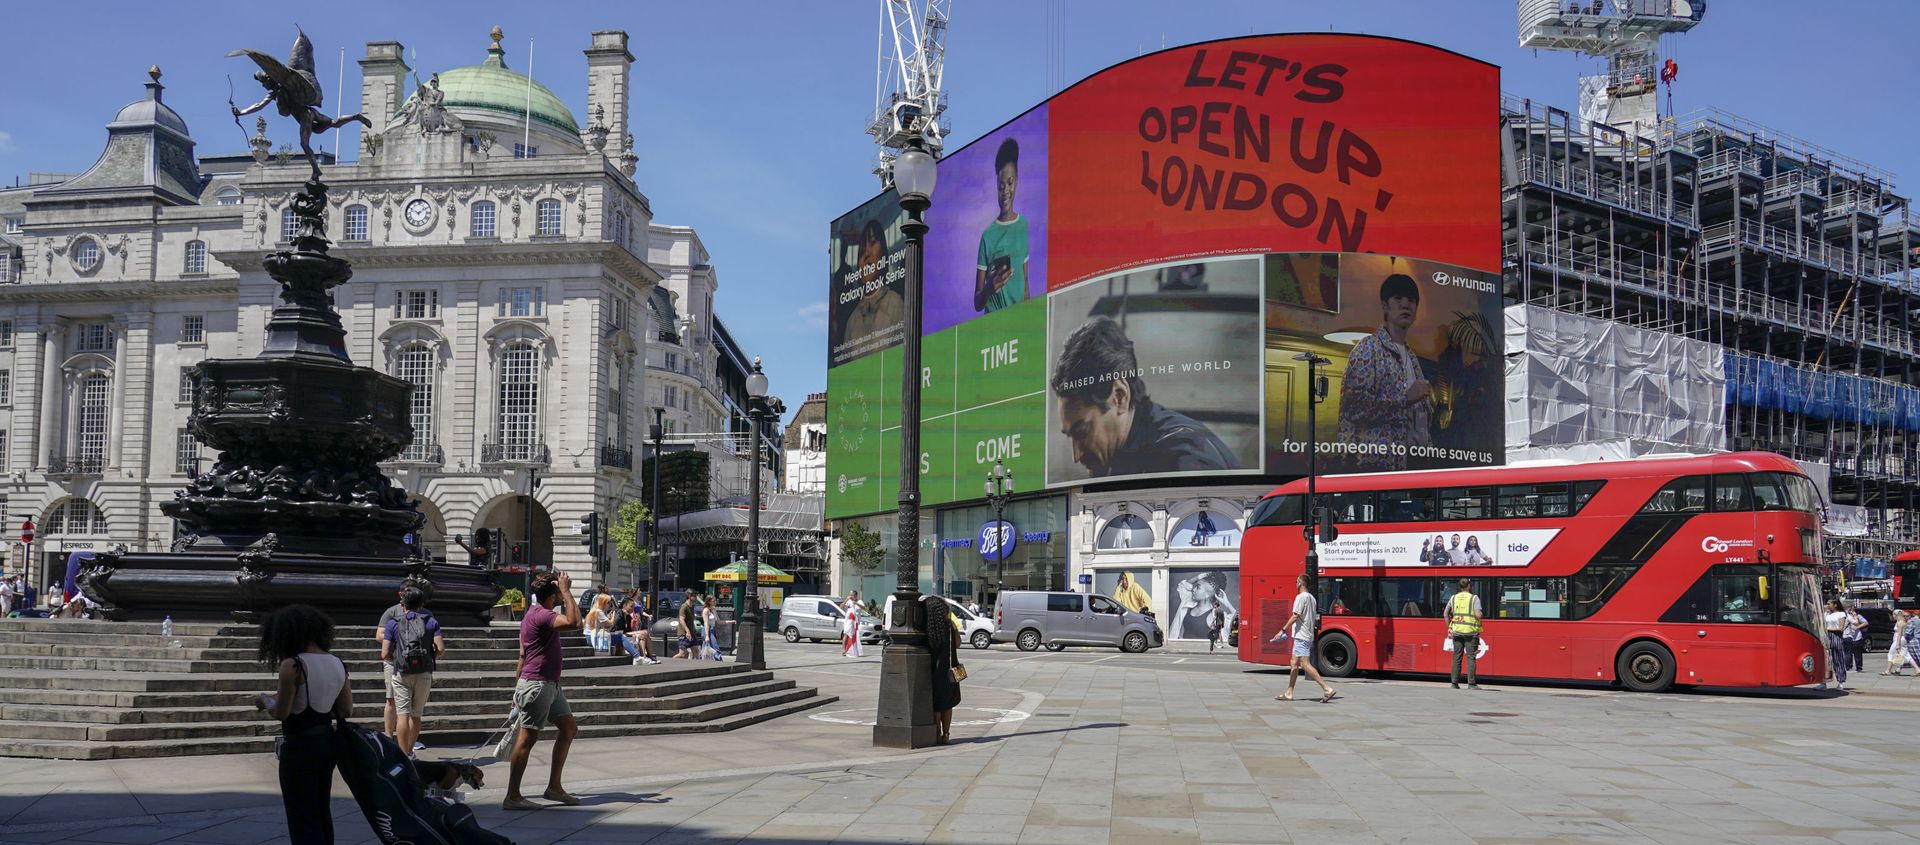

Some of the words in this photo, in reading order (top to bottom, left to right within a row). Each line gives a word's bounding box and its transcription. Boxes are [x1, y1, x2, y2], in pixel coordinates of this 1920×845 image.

[1138, 102, 1270, 164] OPEN
[1141, 151, 1377, 253] LONDON
[844, 267, 863, 286] Meet
[863, 262, 876, 277] the
[876, 248, 906, 271] all-new
[1186, 250, 1209, 258] trademark
[840, 284, 865, 305] Galaxy
[865, 275, 884, 294] Book
[885, 266, 906, 285] Serie
[1452, 276, 1496, 294] HYUNDAI
[981, 338, 1018, 371] TIME
[1063, 376, 1095, 391] RAISED
[1099, 367, 1145, 383] AROUND
[1151, 364, 1175, 375] THE
[1181, 360, 1232, 373] WORLD
[976, 433, 1021, 465] COME
[1282, 438, 1307, 454] for
[1314, 441, 1388, 456] someone
[1390, 441, 1407, 457] to
[1409, 444, 1447, 459] come
[1449, 449, 1477, 462] save
[1478, 452, 1494, 464] us
[941, 537, 972, 549] pharmacy
[980, 526, 1010, 554] Bots
[1391, 546, 1408, 554] 2021.
[1507, 542, 1529, 552] tide
